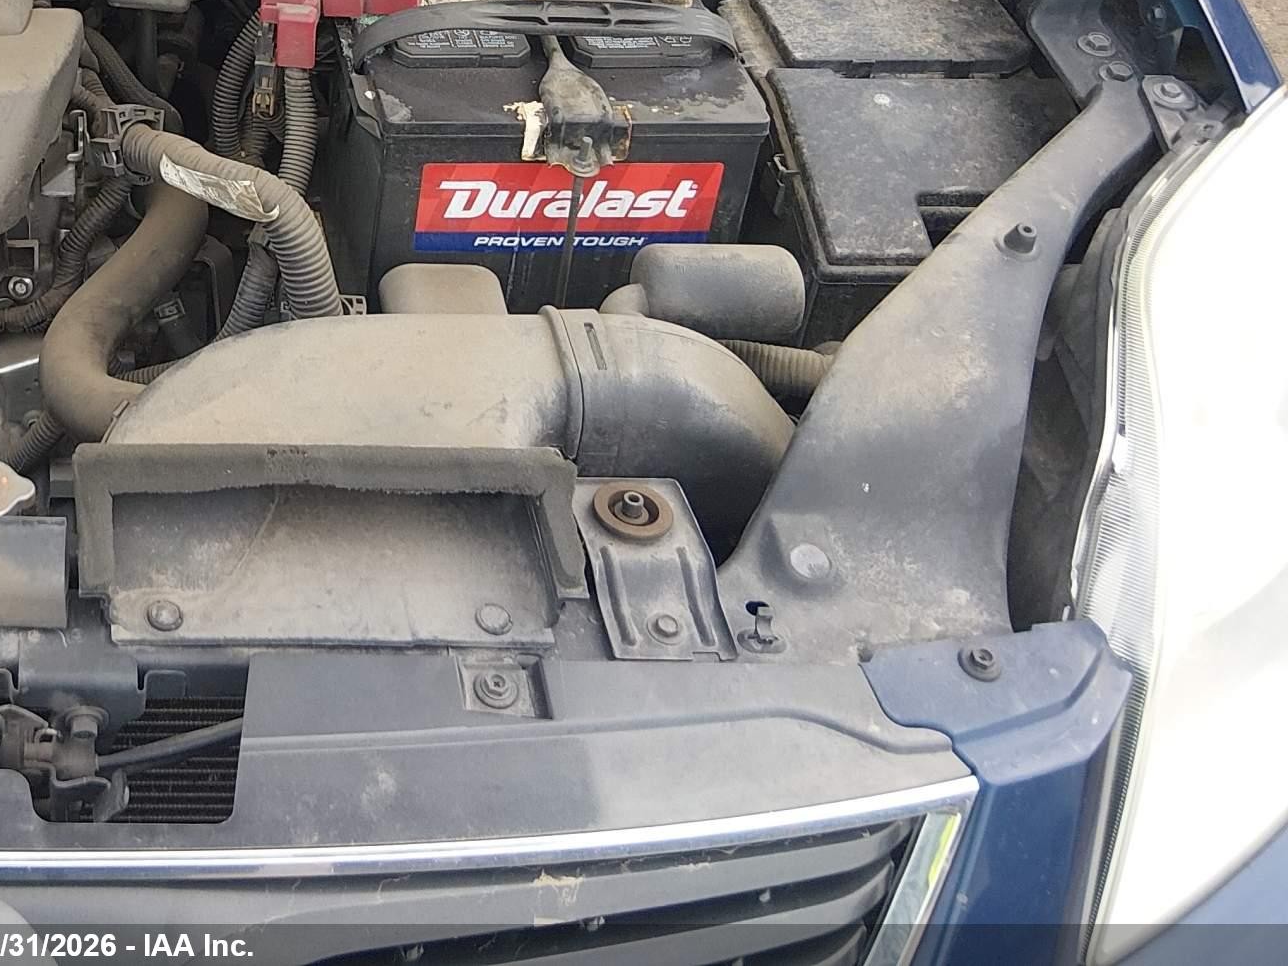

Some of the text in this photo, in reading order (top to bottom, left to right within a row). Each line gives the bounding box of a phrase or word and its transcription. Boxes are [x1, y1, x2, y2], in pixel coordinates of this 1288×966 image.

[439, 179, 697, 219] Duralast
[474, 236, 645, 247] PROVEN TOUGH
